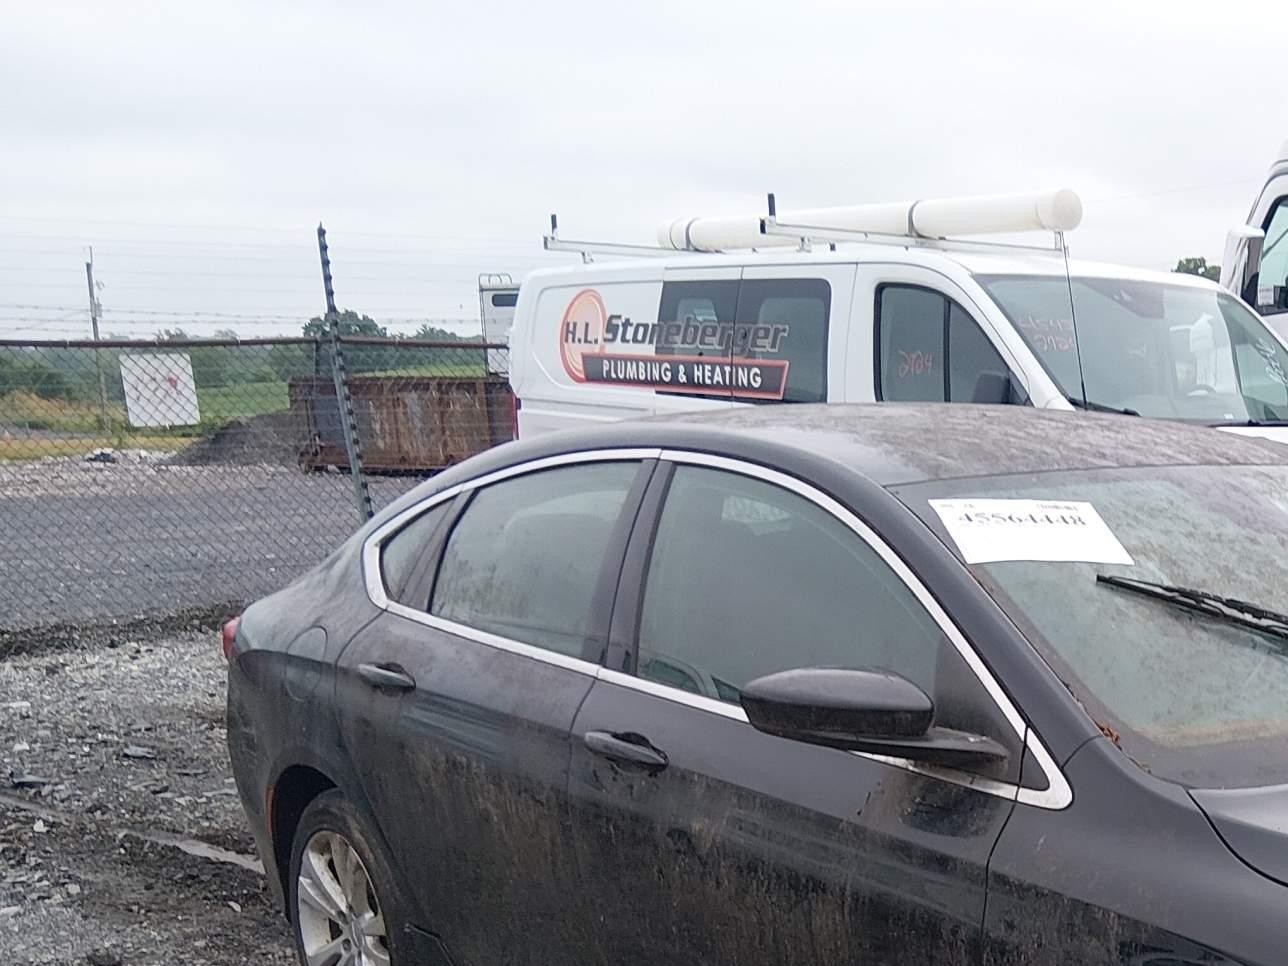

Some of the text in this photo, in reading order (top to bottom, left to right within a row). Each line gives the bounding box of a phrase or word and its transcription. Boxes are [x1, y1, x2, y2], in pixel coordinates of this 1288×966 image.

[564, 314, 789, 357] H.L. Stoneberger
[602, 359, 762, 389] PLUMBING & HEATING
